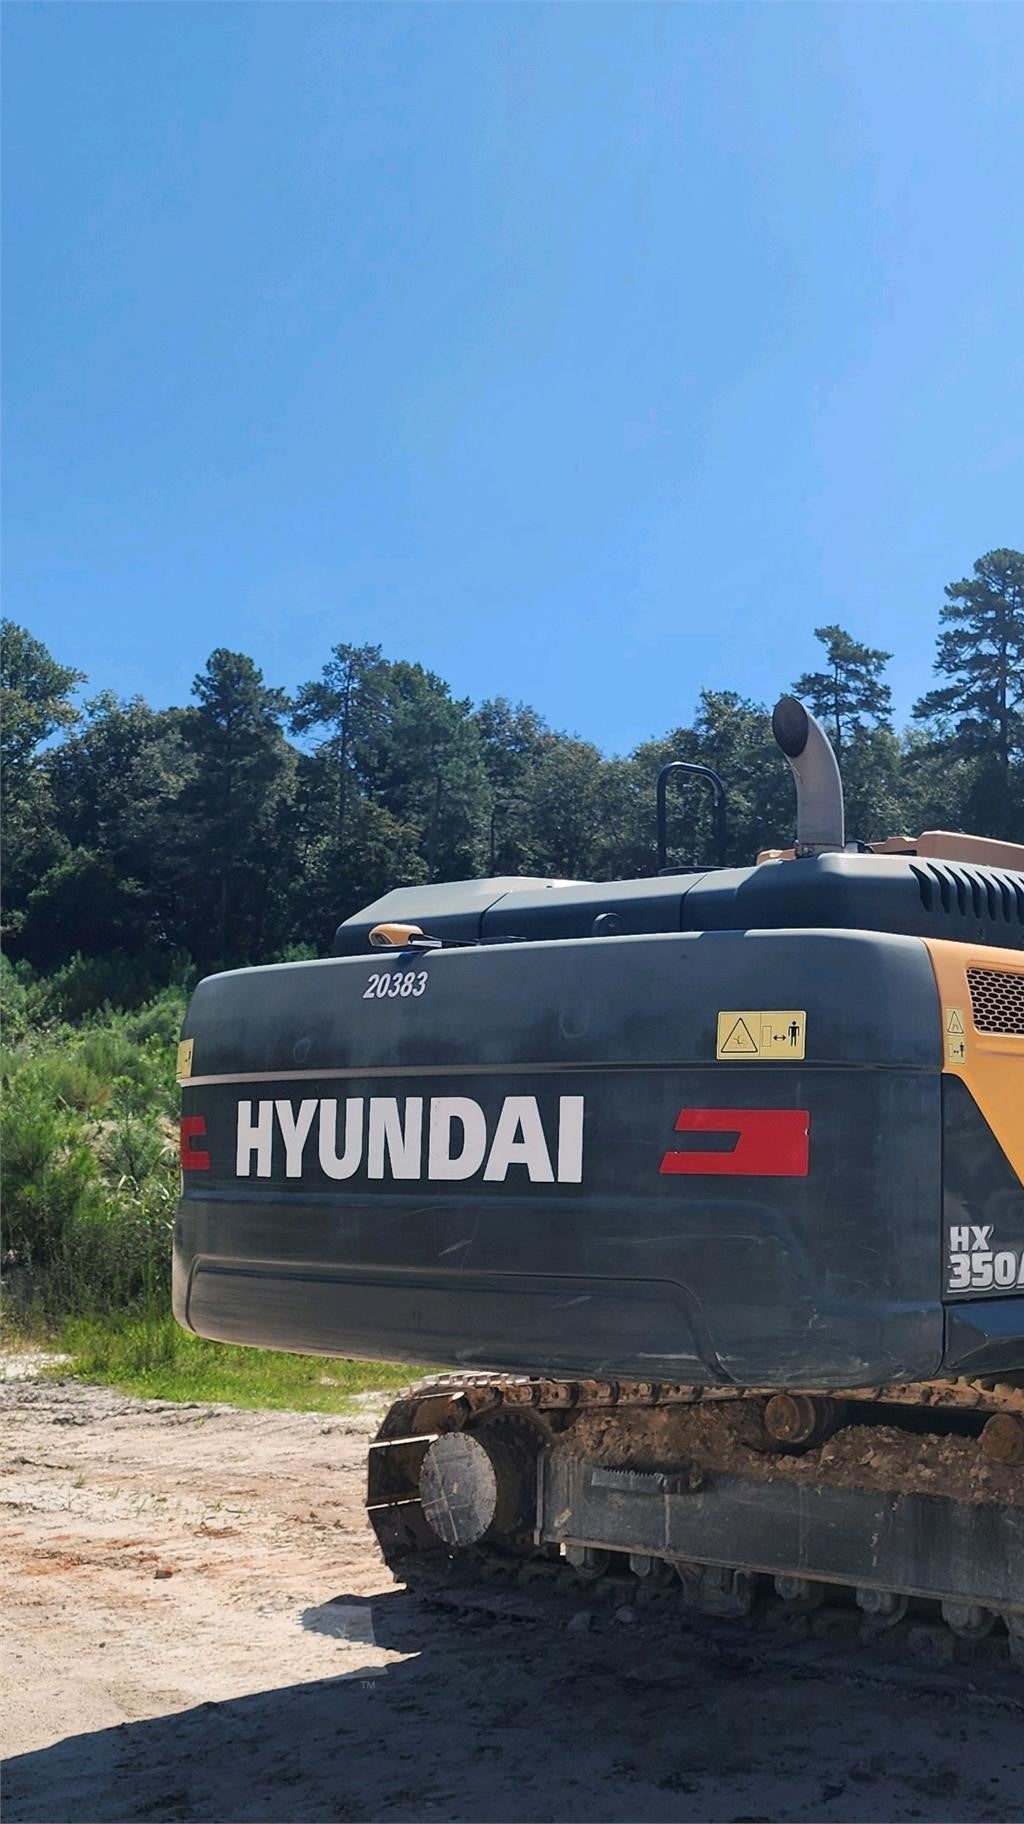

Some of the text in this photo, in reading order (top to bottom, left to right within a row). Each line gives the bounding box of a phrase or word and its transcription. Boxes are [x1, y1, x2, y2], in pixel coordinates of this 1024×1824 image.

[362, 971, 428, 998] 20383
[236, 1095, 585, 1183] HYUNDAI
[949, 1225, 992, 1252] HX
